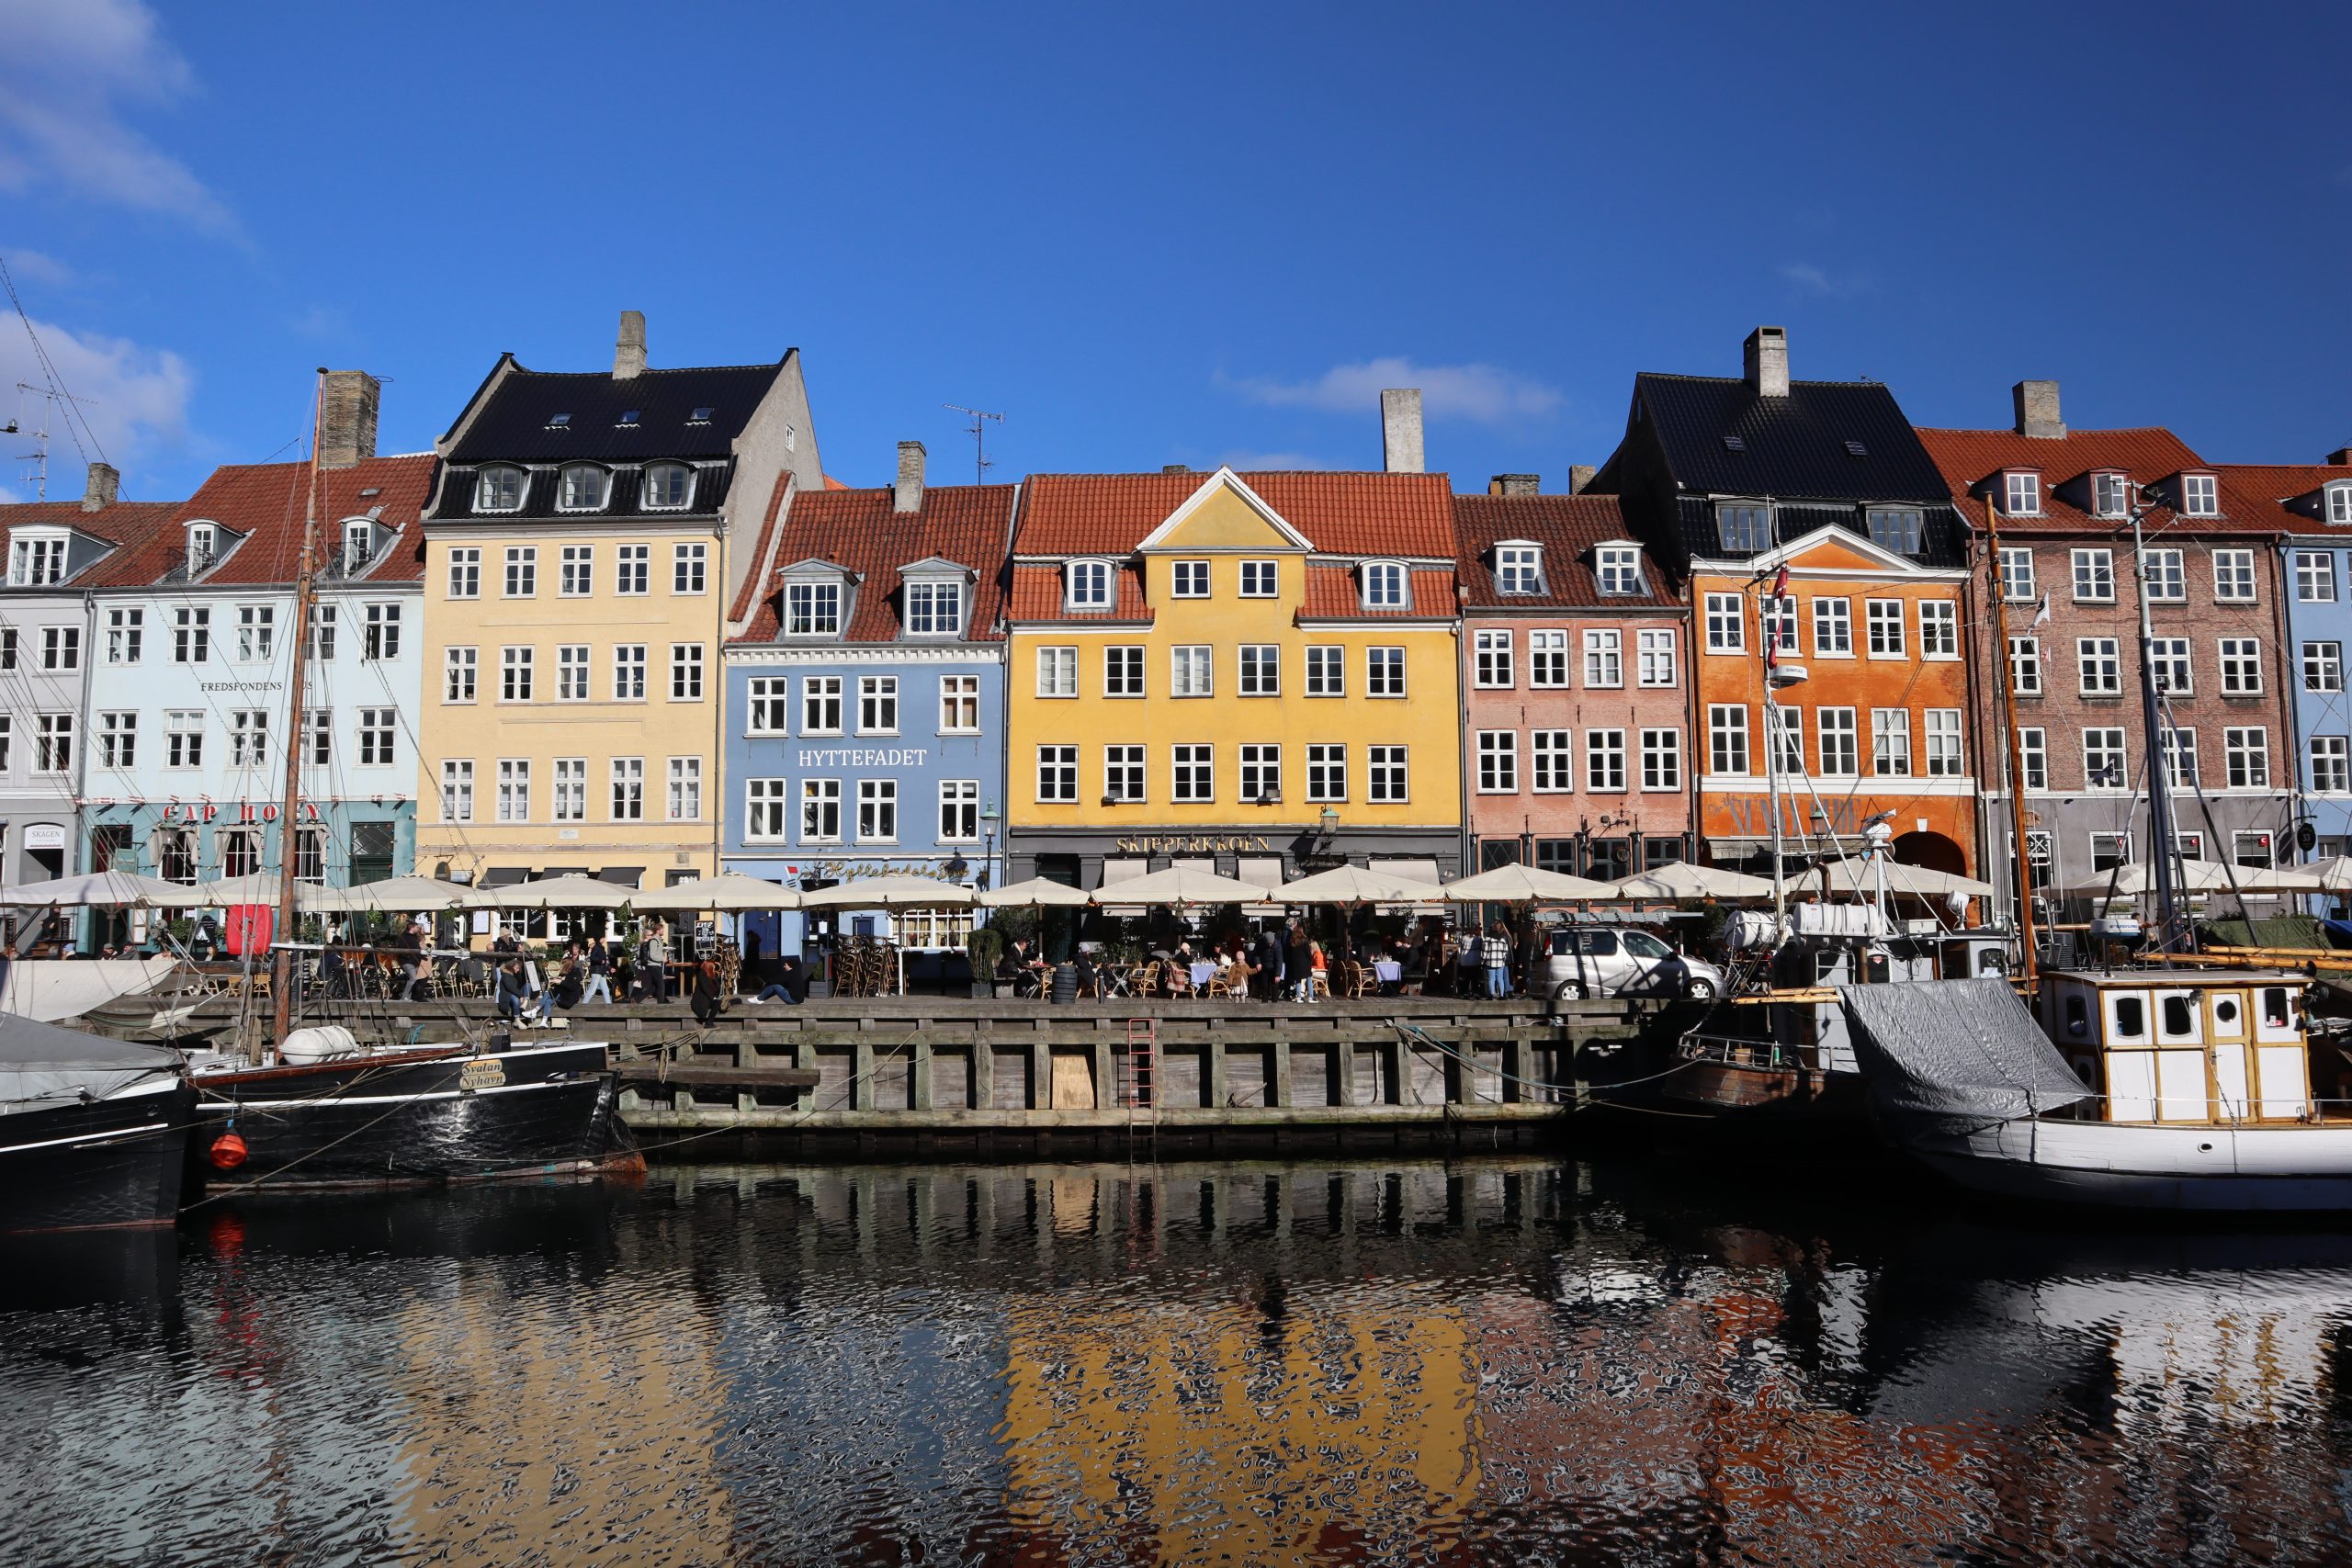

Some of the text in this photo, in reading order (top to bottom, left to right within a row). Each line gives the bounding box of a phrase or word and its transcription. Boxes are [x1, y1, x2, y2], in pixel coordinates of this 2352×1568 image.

[200, 682, 282, 692] FREDSFONDENS
[798, 749, 927, 766] HYTTEFADET
[163, 805, 219, 821] CAP
[1116, 837, 1270, 852] SKIPPERKROEN
[462, 1062, 501, 1074] Svalan
[461, 1076, 503, 1087] Nyhavn
